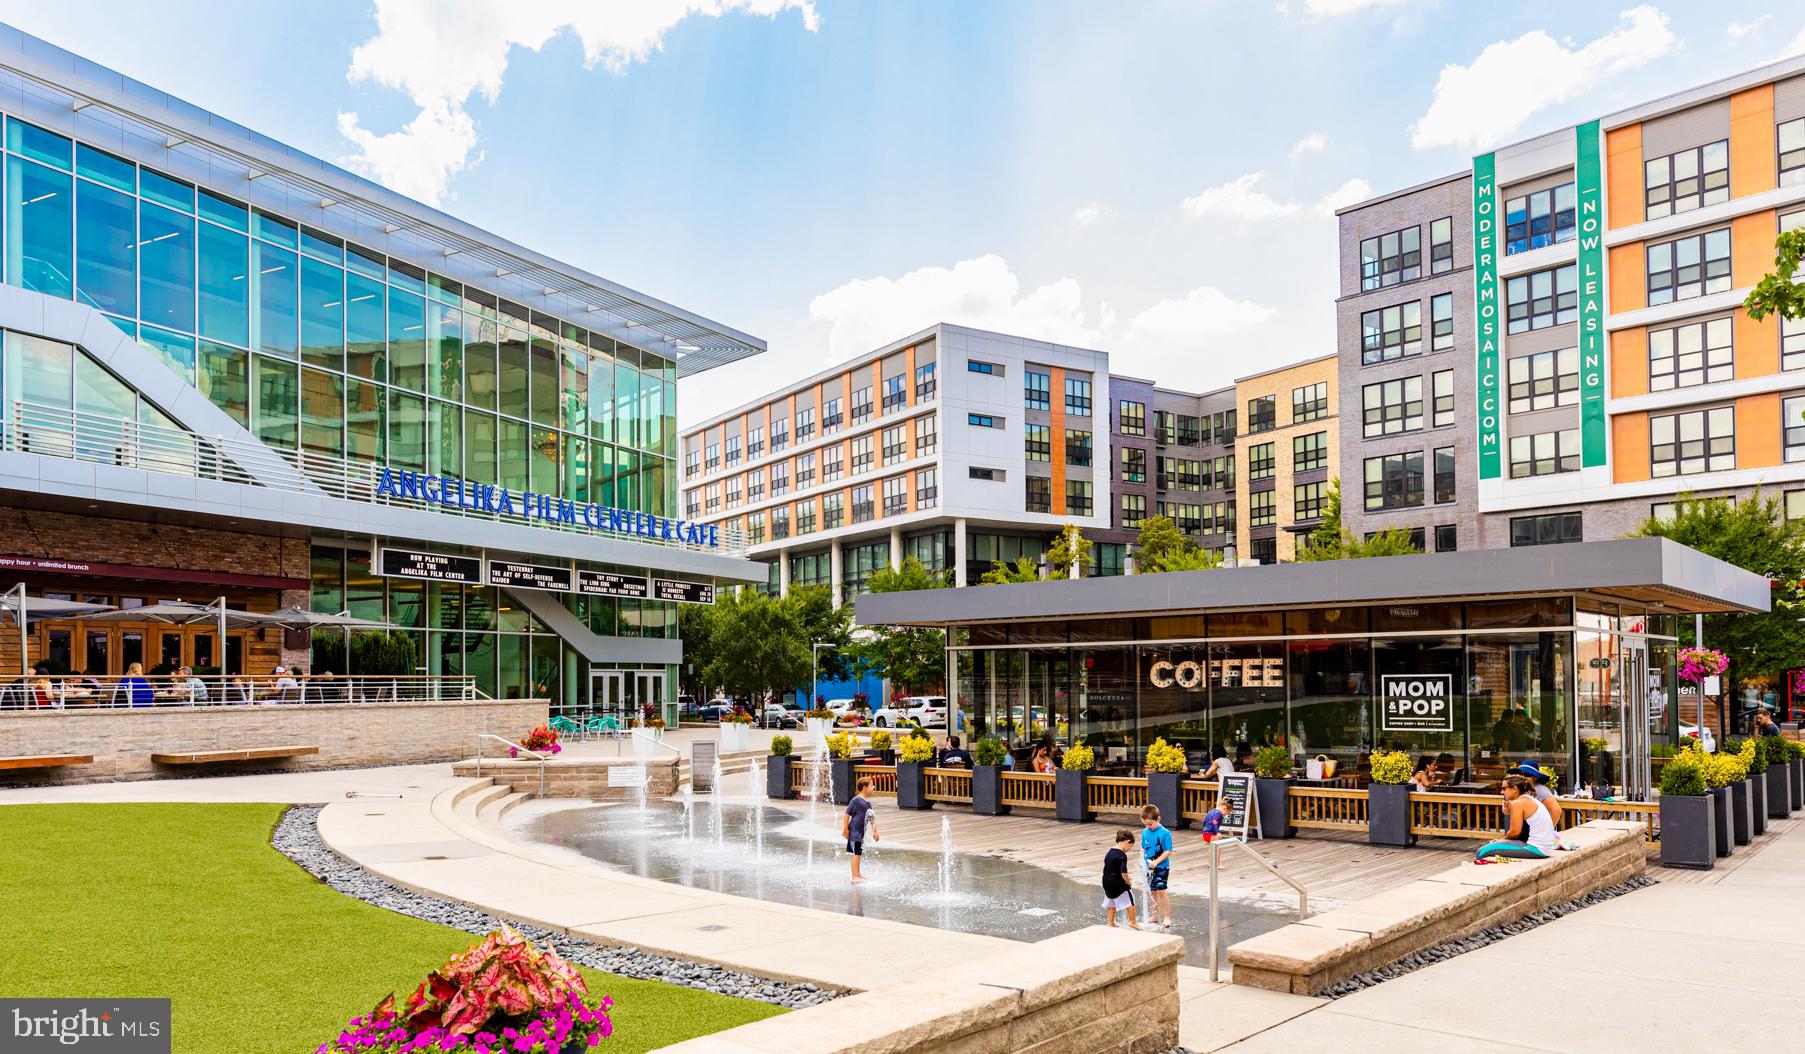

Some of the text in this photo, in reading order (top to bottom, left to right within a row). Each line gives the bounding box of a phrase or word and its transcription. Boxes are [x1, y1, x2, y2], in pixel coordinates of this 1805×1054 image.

[1581, 199, 1599, 386] NOW LEASING
[1478, 183, 1496, 447] MODERAMOSAIC.COM
[377, 467, 720, 548] ANGELIKA FILM CENTER & CAFE
[37, 561, 67, 569] unlimited
[67, 563, 89, 571] brunch
[410, 554, 449, 565] NOW PLAYING
[400, 567, 465, 580] ANGELIKA FILM CENTER
[491, 569, 501, 577] THE
[522, 573, 553, 582] SELF-DEFENSE
[507, 564, 534, 574] YESTERDAY
[537, 580, 546, 588] THE
[547, 582, 570, 590] FAREWELL
[1149, 658, 1284, 689] COFFEE
[1388, 681, 1444, 697] MOM
[1388, 699, 1445, 715] & POP
